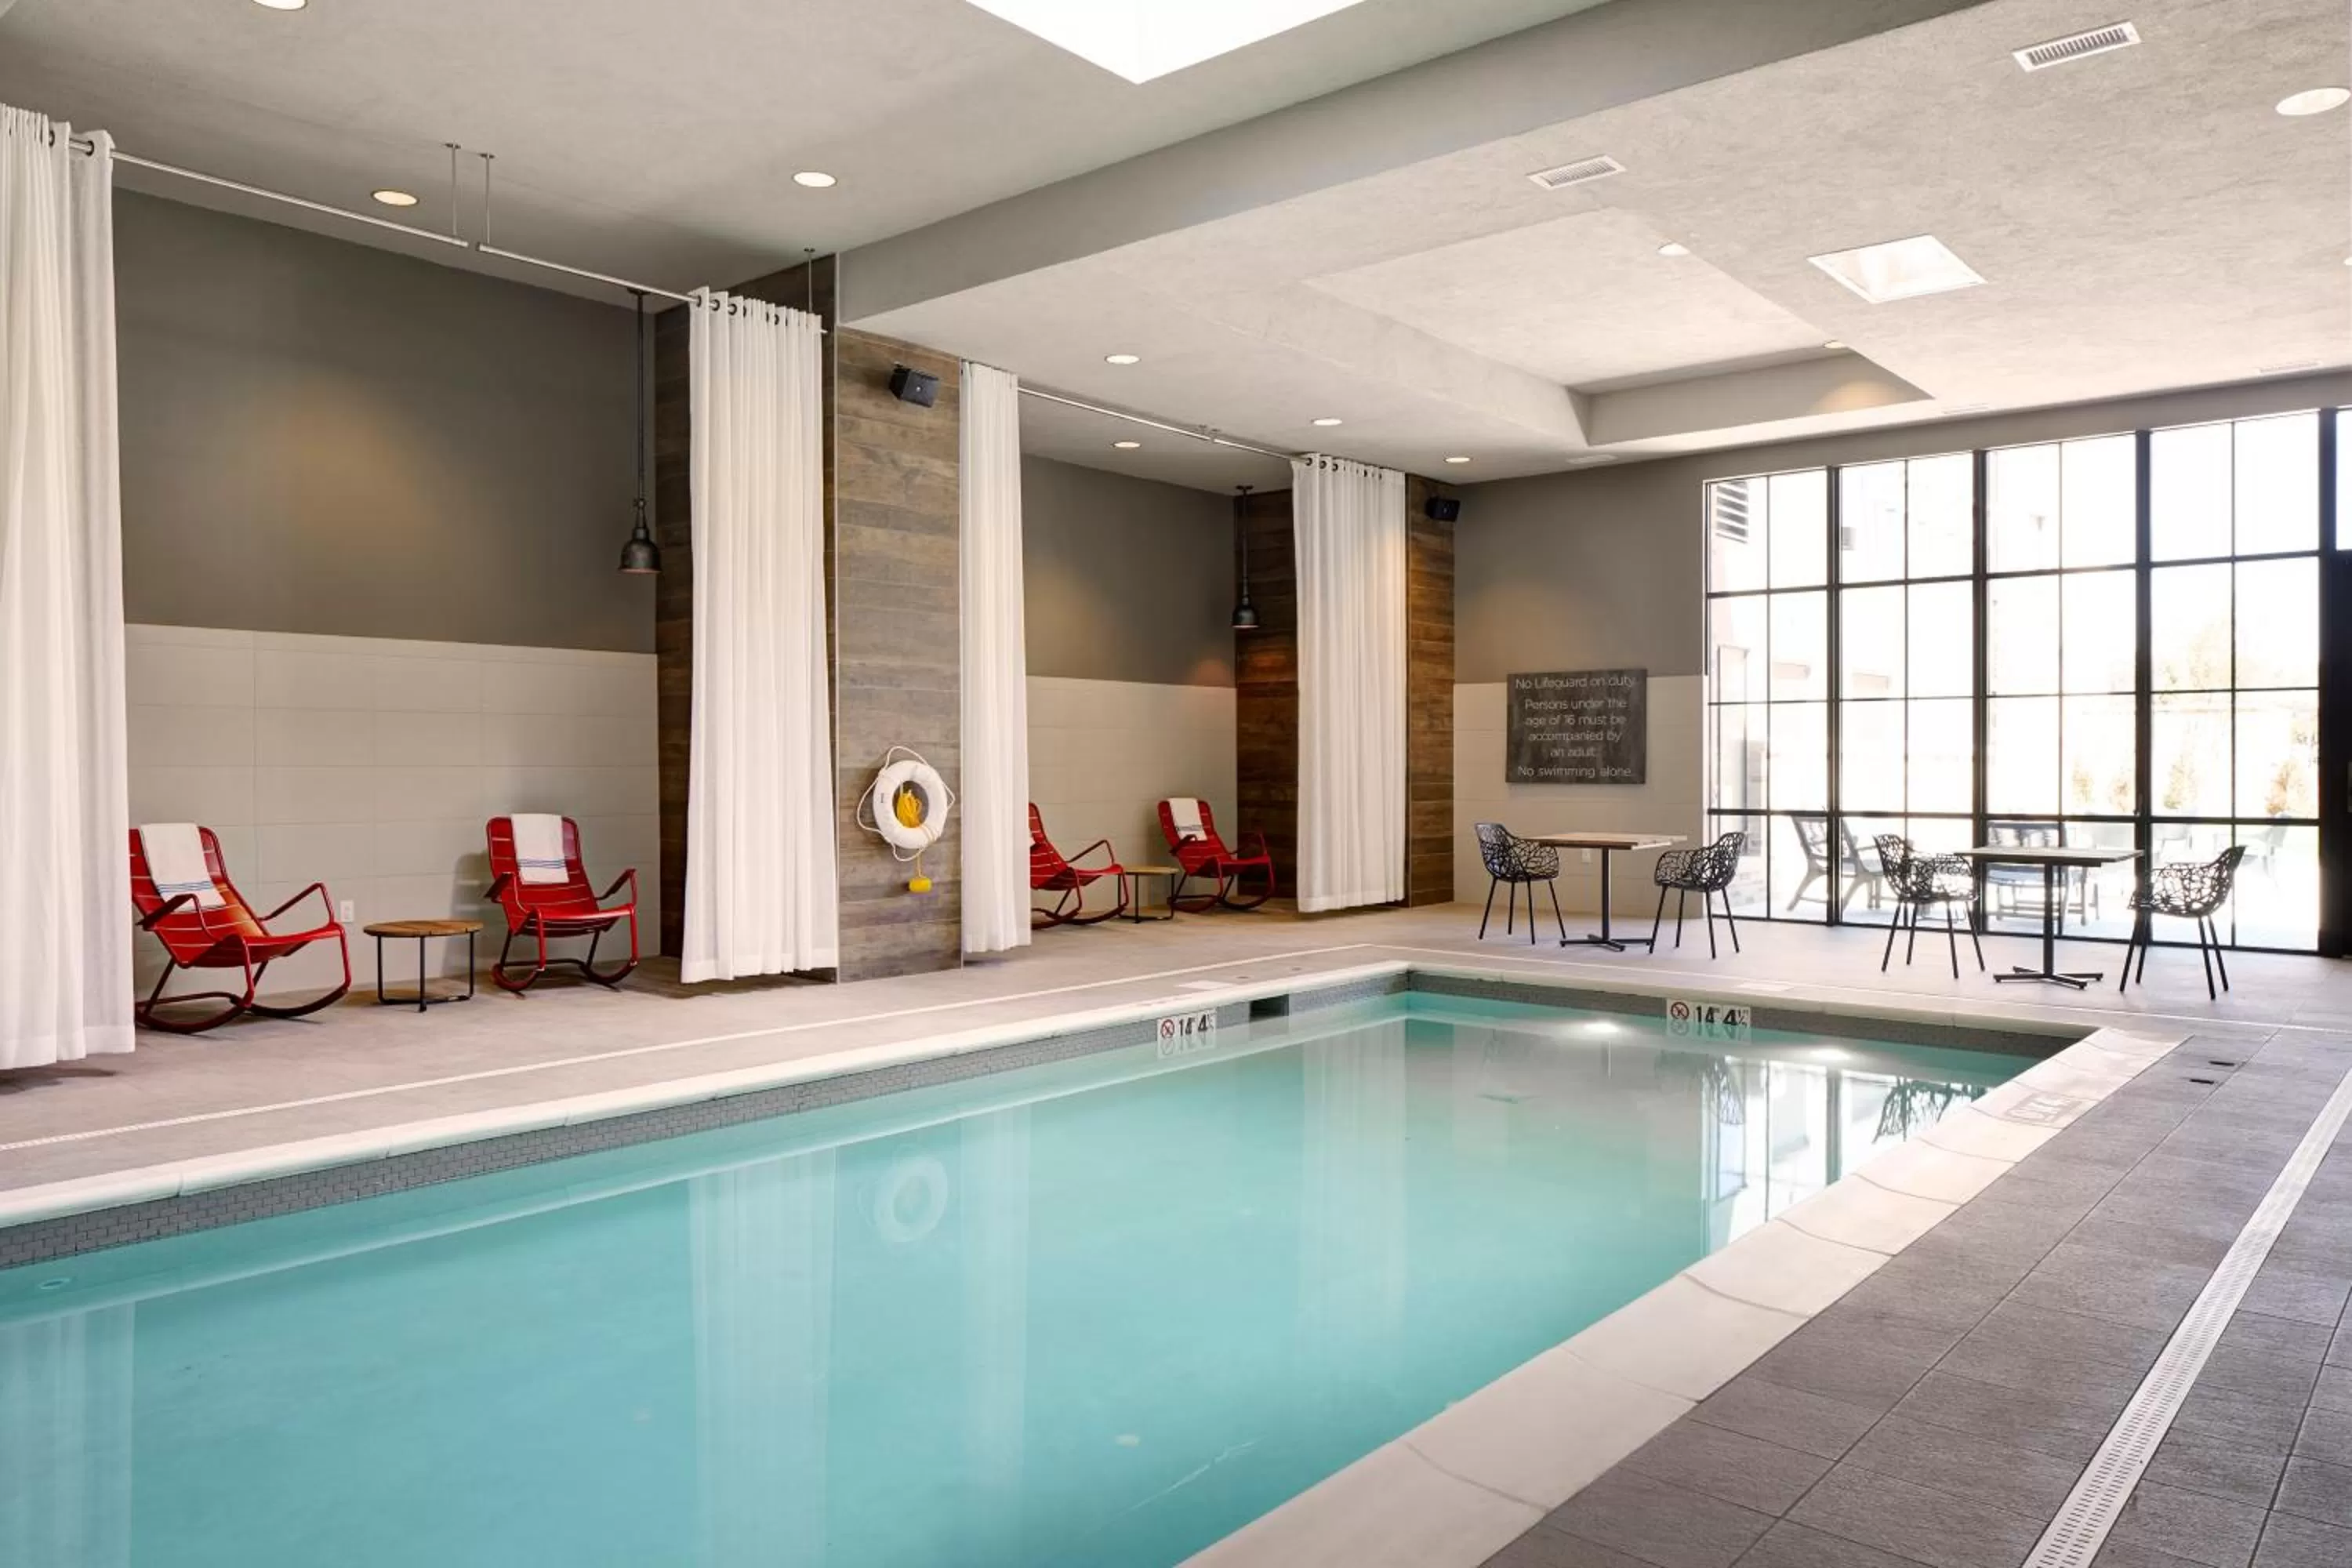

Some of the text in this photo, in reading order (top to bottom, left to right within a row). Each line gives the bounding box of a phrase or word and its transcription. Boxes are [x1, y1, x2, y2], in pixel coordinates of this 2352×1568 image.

[1515, 677, 1531, 689] No
[1590, 677, 1606, 688] on
[1525, 698, 1628, 710] Persons under the
[1524, 713, 1627, 728] age of 16 must be
[1529, 730, 1623, 743] accompanied by
[1550, 749, 1564, 757] an
[1518, 765, 1534, 776] No
[1537, 765, 1595, 779] swimming
